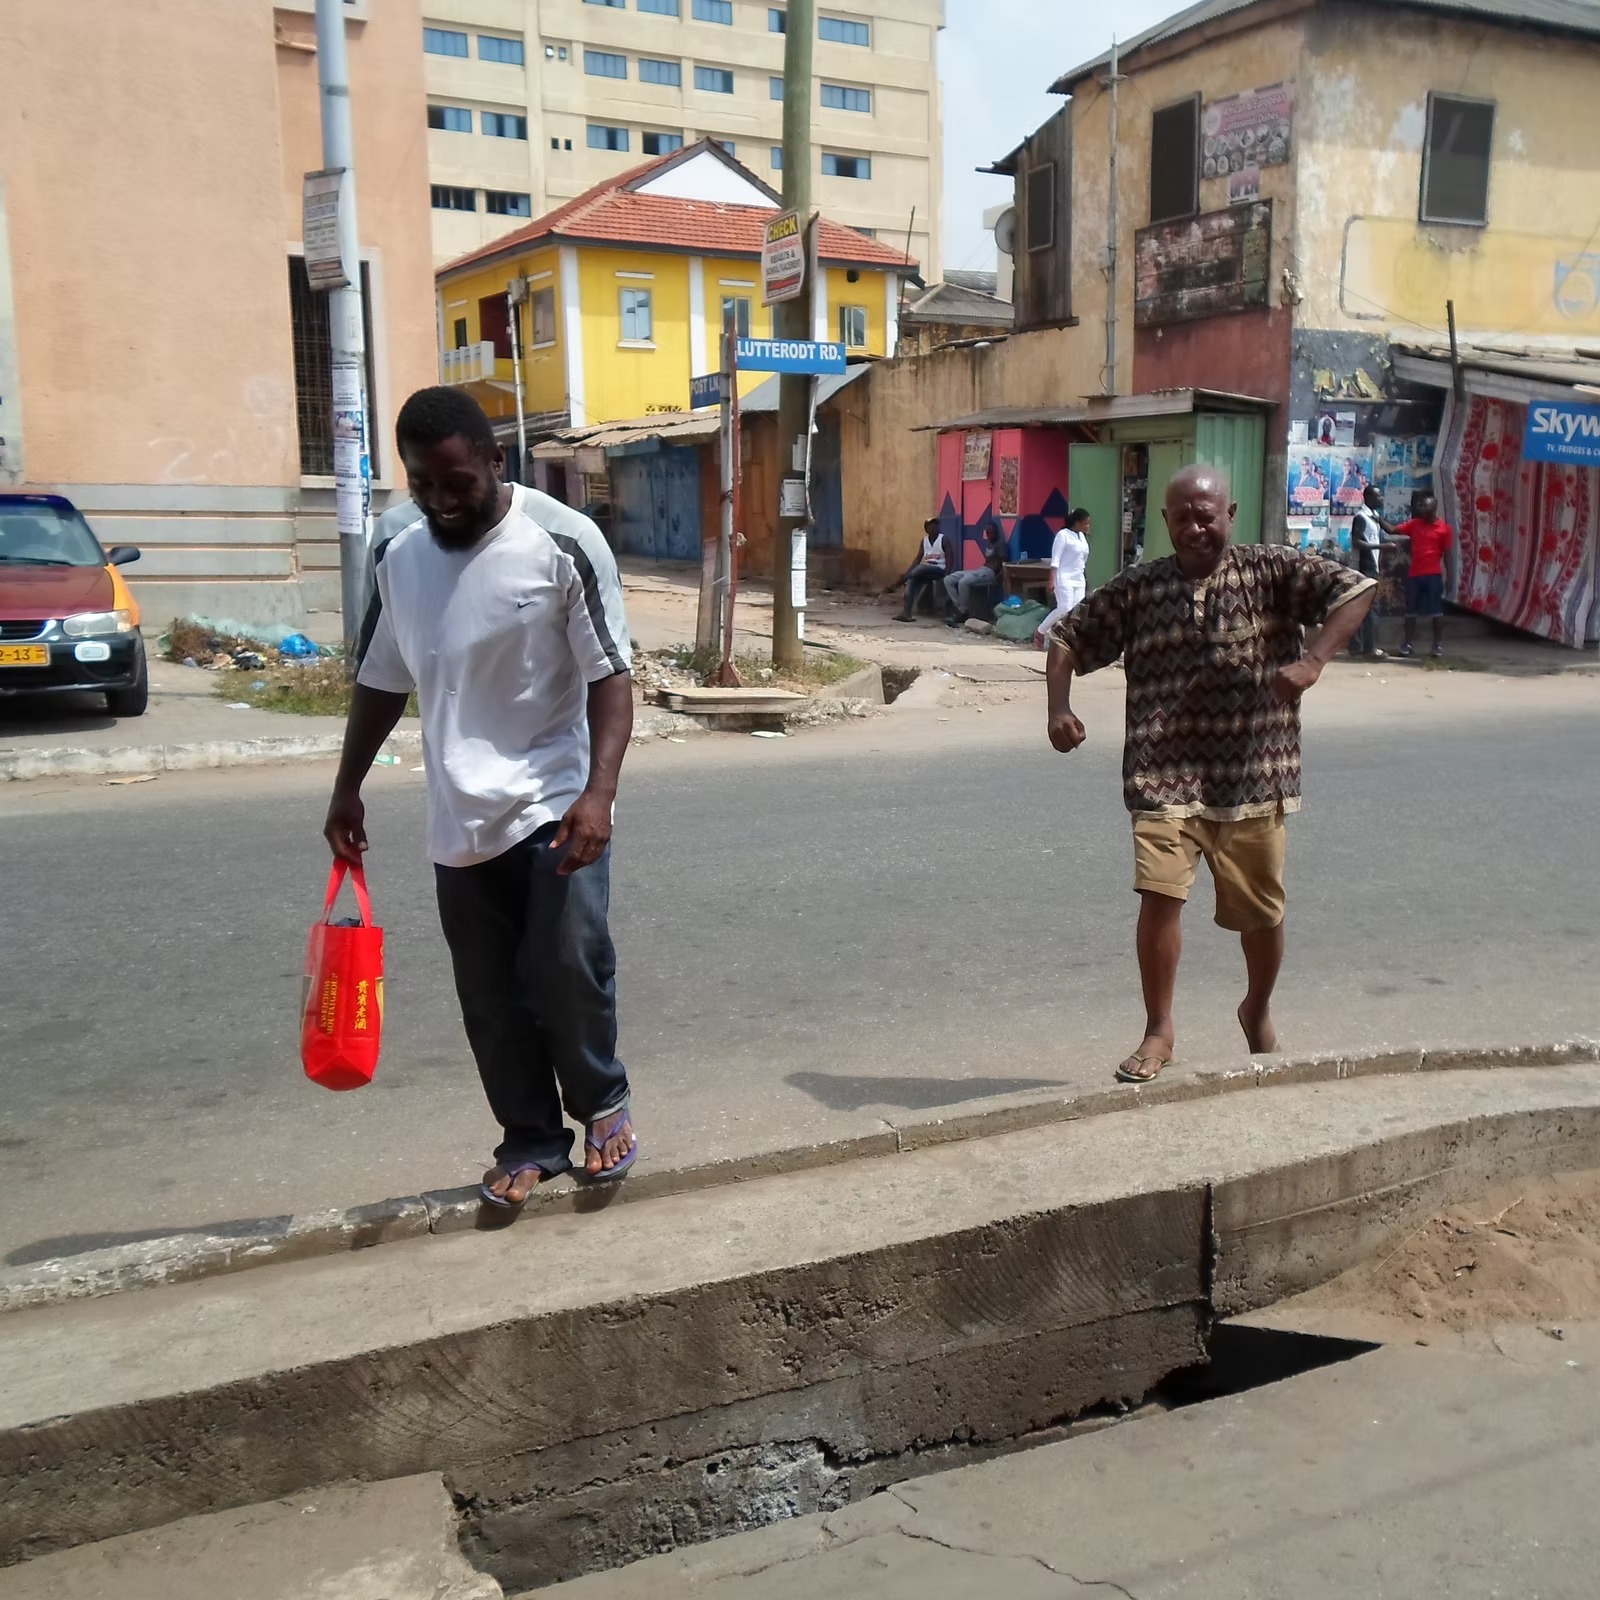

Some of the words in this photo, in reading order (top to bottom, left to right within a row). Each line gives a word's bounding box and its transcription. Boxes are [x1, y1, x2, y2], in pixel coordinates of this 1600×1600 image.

[768, 216, 798, 241] CHECK
[737, 340, 816, 360] LUTTERODT
[820, 344, 842, 360] RD.
[690, 378, 708, 395] POST
